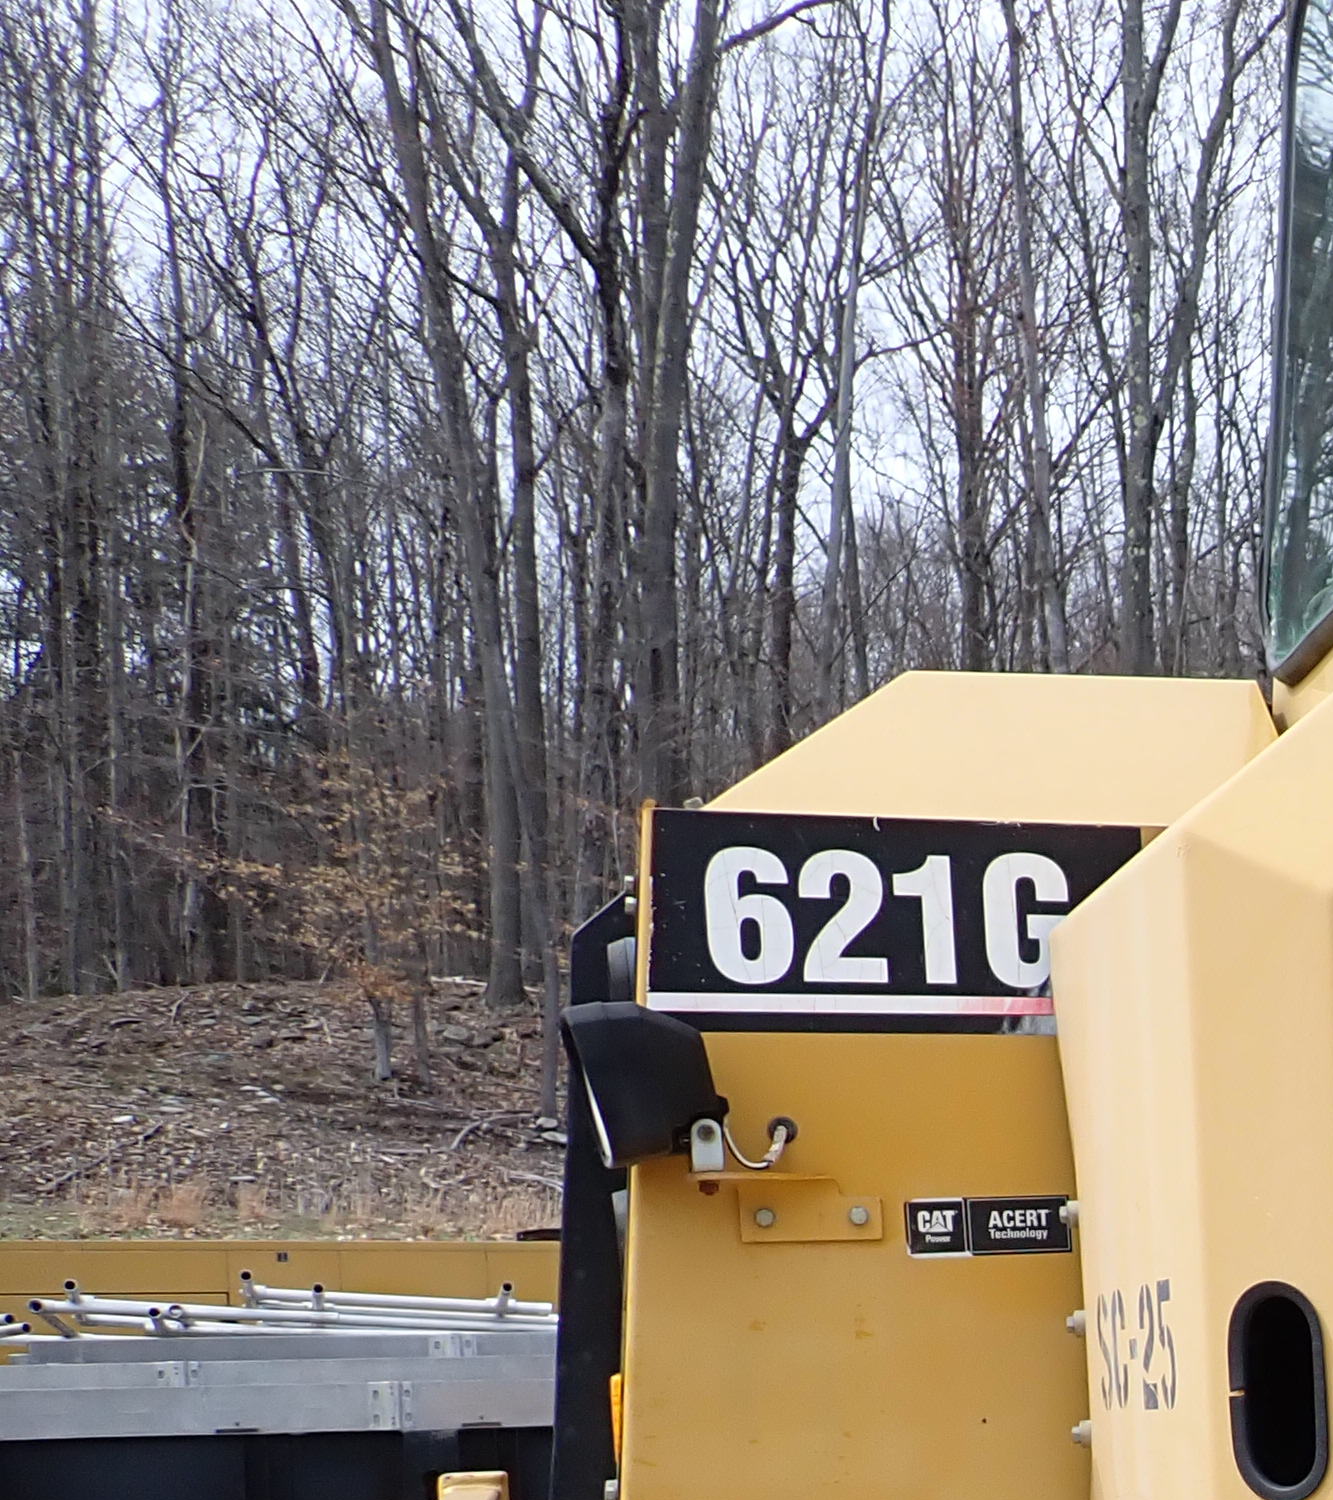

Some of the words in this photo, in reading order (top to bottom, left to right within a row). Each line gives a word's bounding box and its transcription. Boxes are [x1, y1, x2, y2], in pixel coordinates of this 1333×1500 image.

[704, 846, 1069, 989] 621G
[917, 1210, 957, 1233] CAT
[988, 1209, 1049, 1228] ACERT
[988, 1228, 1049, 1240] Technology
[1097, 1279, 1176, 1411] SC-25
